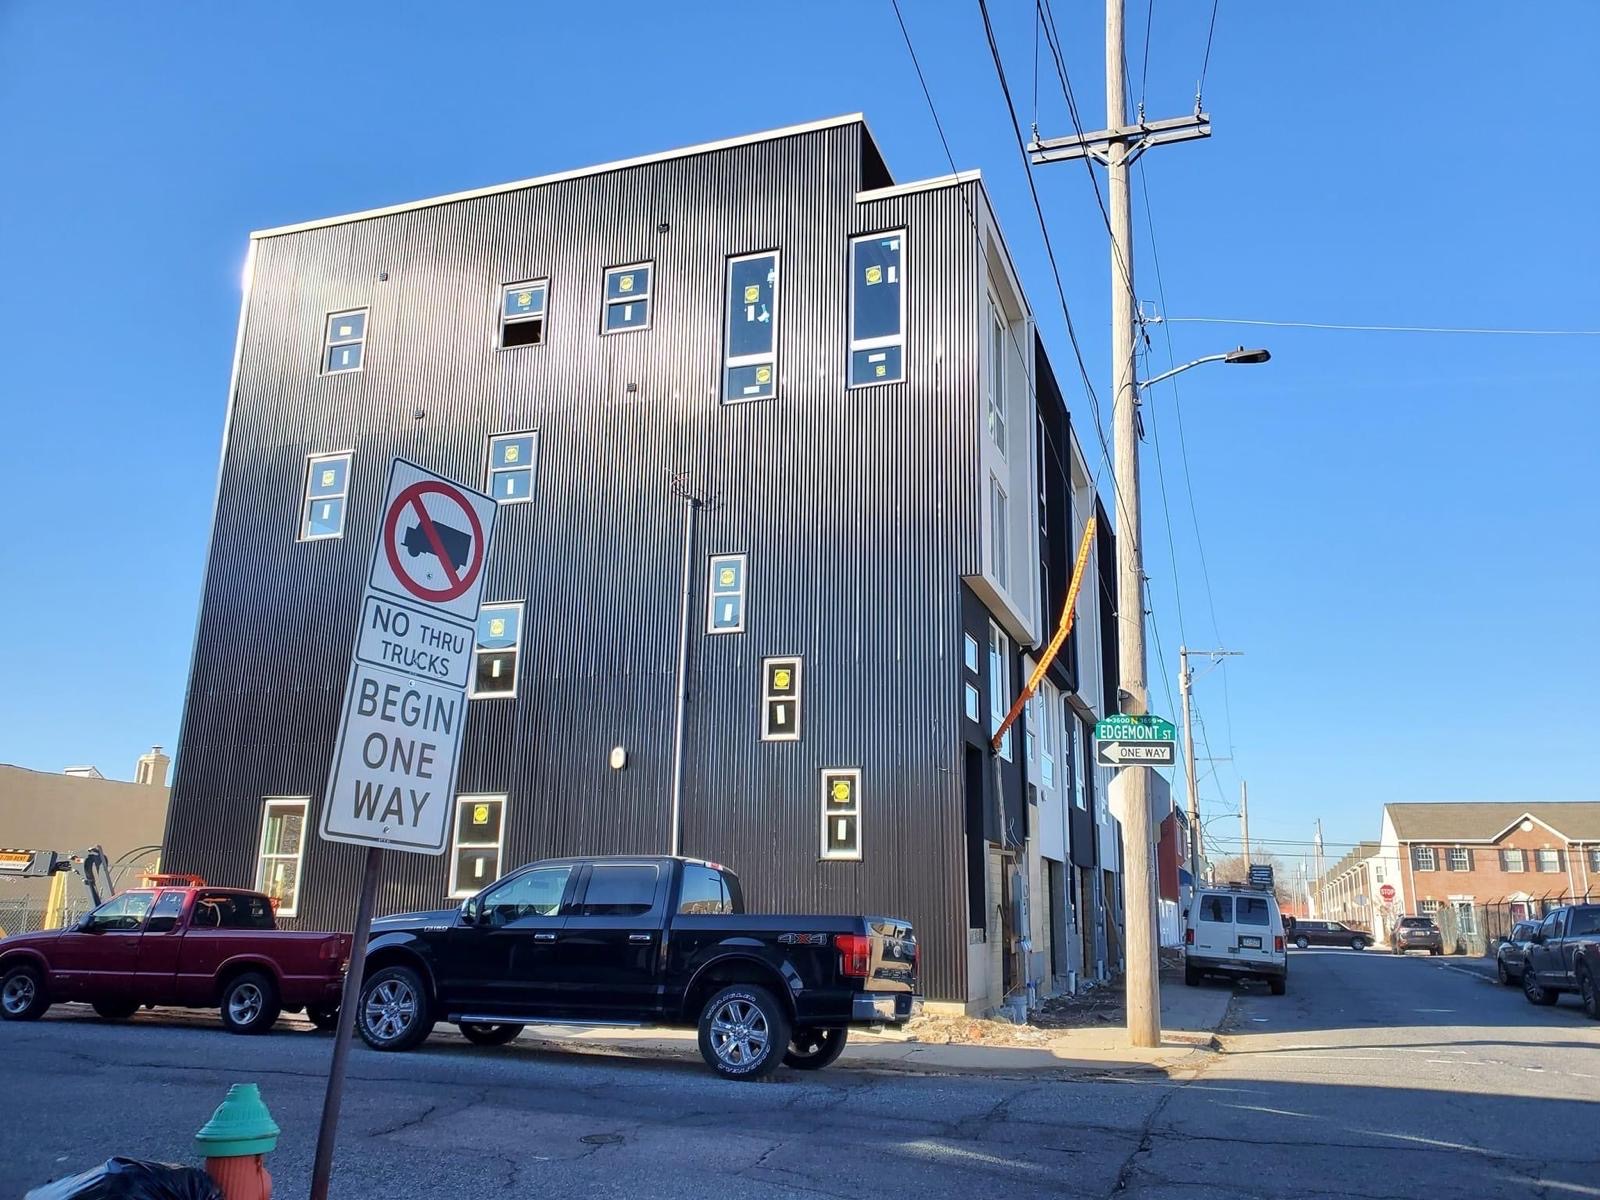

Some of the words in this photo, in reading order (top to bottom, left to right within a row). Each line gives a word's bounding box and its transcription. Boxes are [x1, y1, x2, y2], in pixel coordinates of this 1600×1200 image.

[372, 605, 410, 637] NO
[420, 625, 465, 655] THRU
[381, 640, 450, 677] TRUCKS
[357, 678, 455, 735] BEGIN
[362, 732, 437, 780] ONE
[1100, 725, 1160, 739] EDGEMONT
[1162, 730, 1171, 739] ST
[1120, 748, 1140, 757] ONE
[1145, 748, 1166, 757] WAY
[353, 779, 431, 828] WAY
